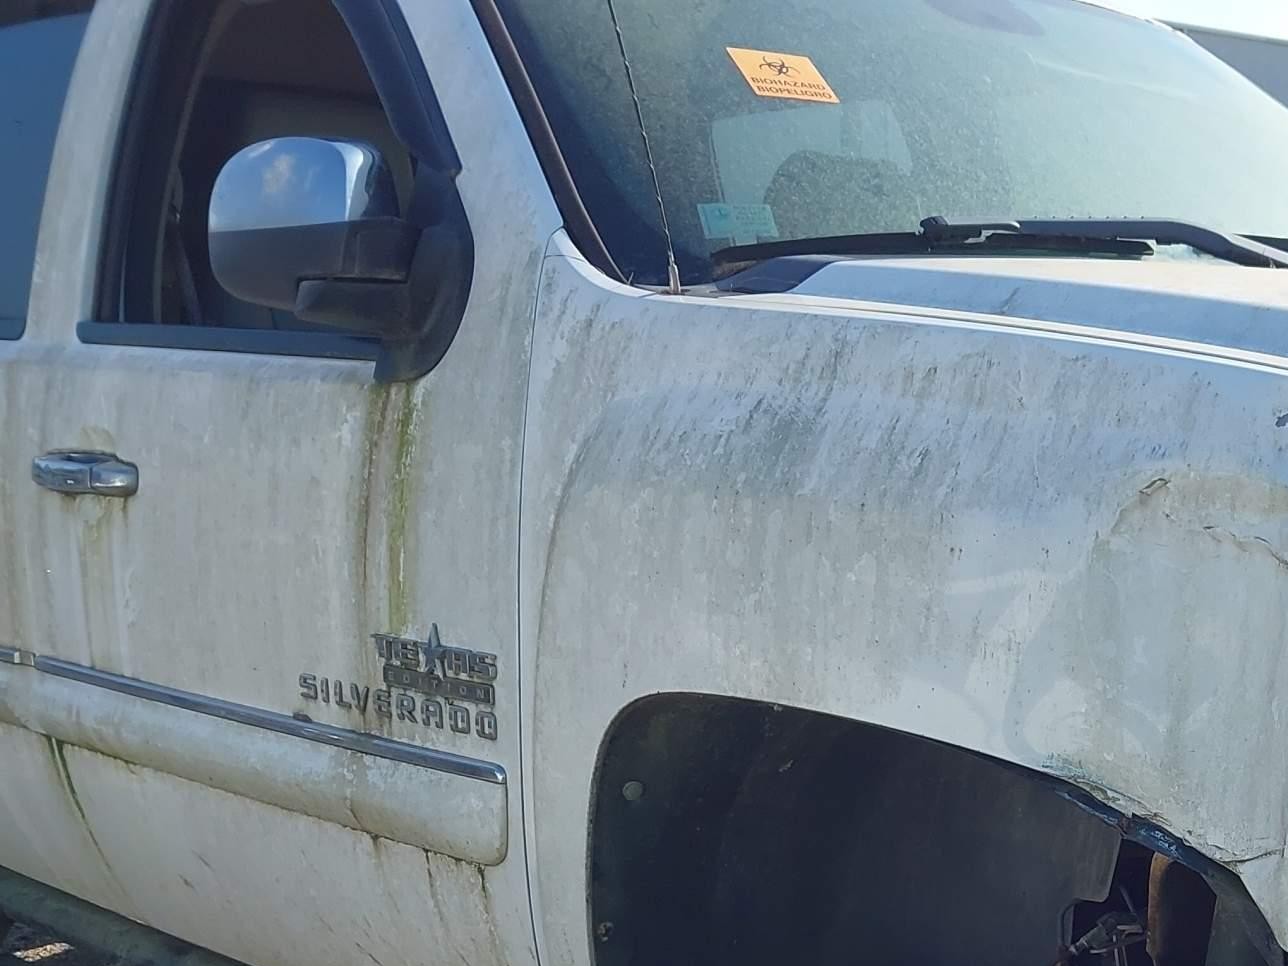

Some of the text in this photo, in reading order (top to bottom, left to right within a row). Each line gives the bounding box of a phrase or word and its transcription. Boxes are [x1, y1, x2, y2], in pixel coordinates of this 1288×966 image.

[751, 77, 826, 91] BIOHAZARD
[756, 85, 833, 99] BIOPELIGRO
[299, 672, 498, 741] SILVERADO
